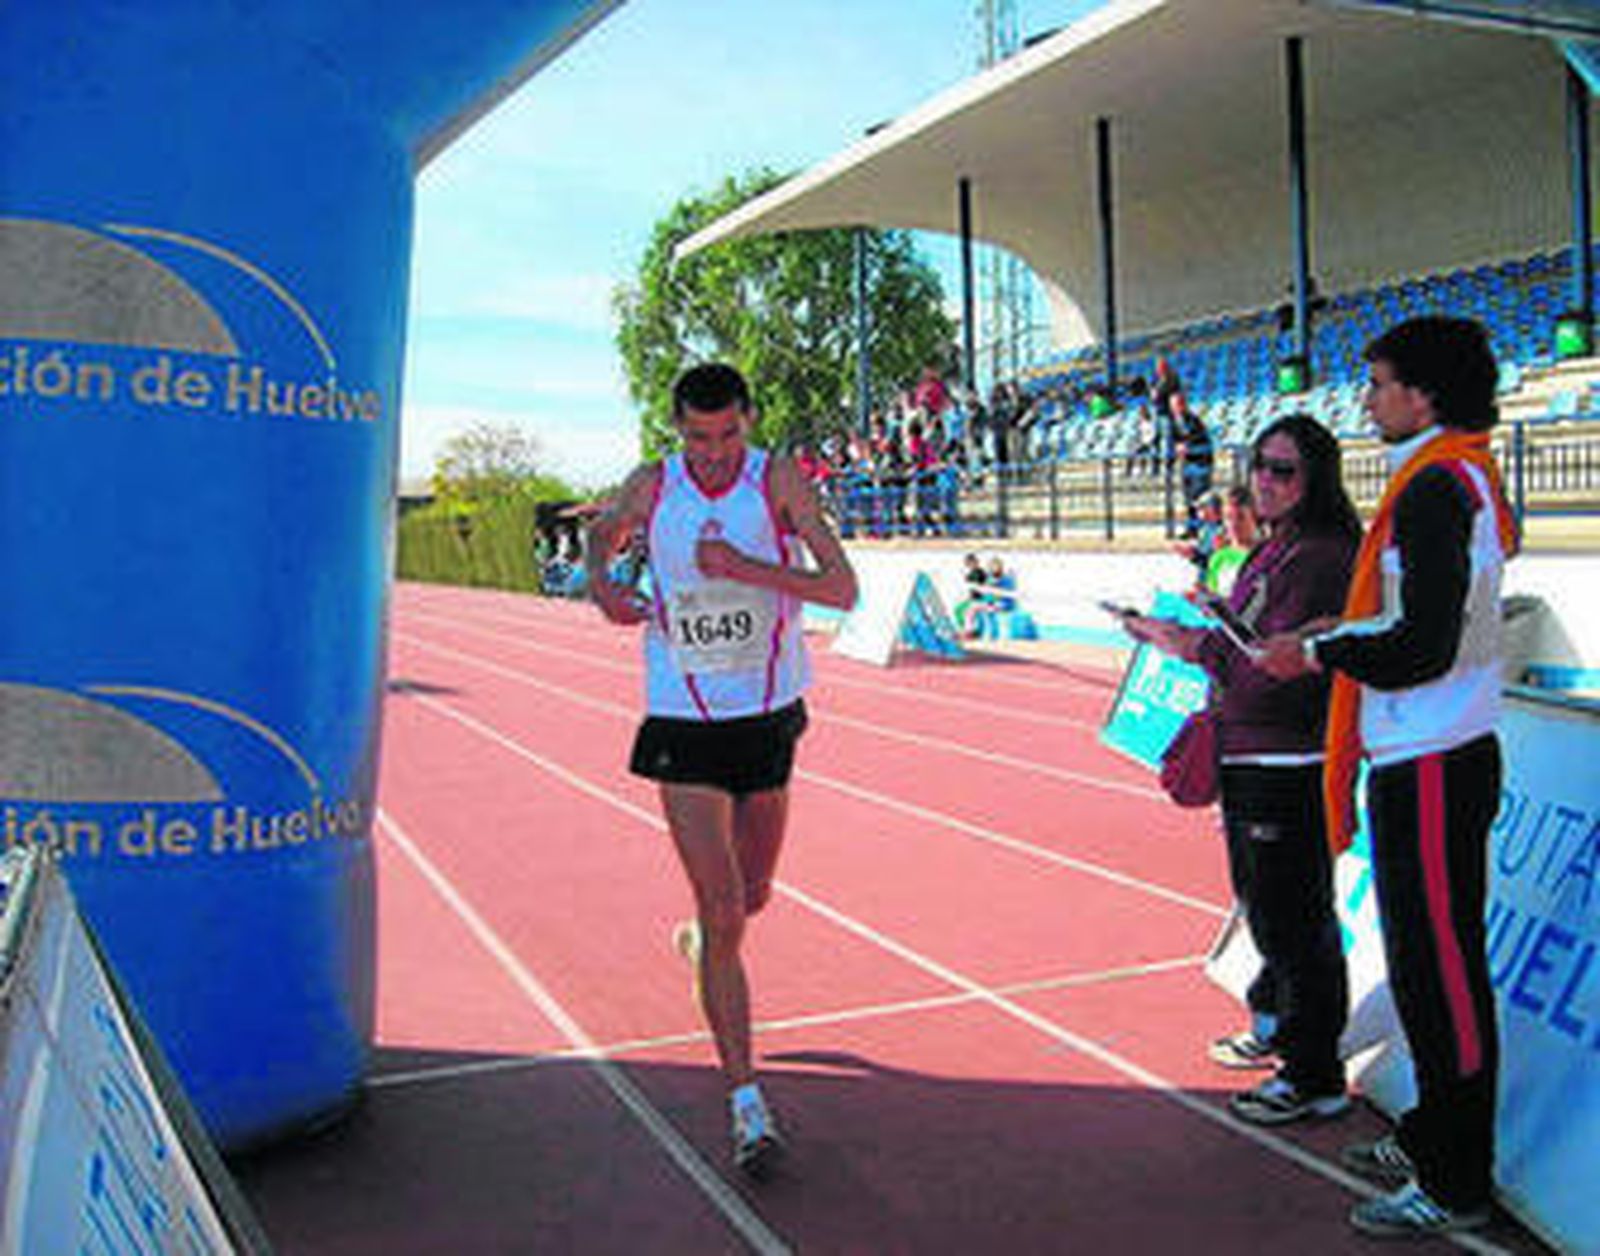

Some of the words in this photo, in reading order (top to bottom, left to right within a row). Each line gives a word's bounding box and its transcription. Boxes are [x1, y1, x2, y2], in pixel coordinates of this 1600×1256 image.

[132, 356, 212, 407] de
[226, 363, 383, 420] Huelva
[681, 610, 752, 645] 1649
[119, 811, 197, 856] de
[213, 796, 360, 853] Huelva
